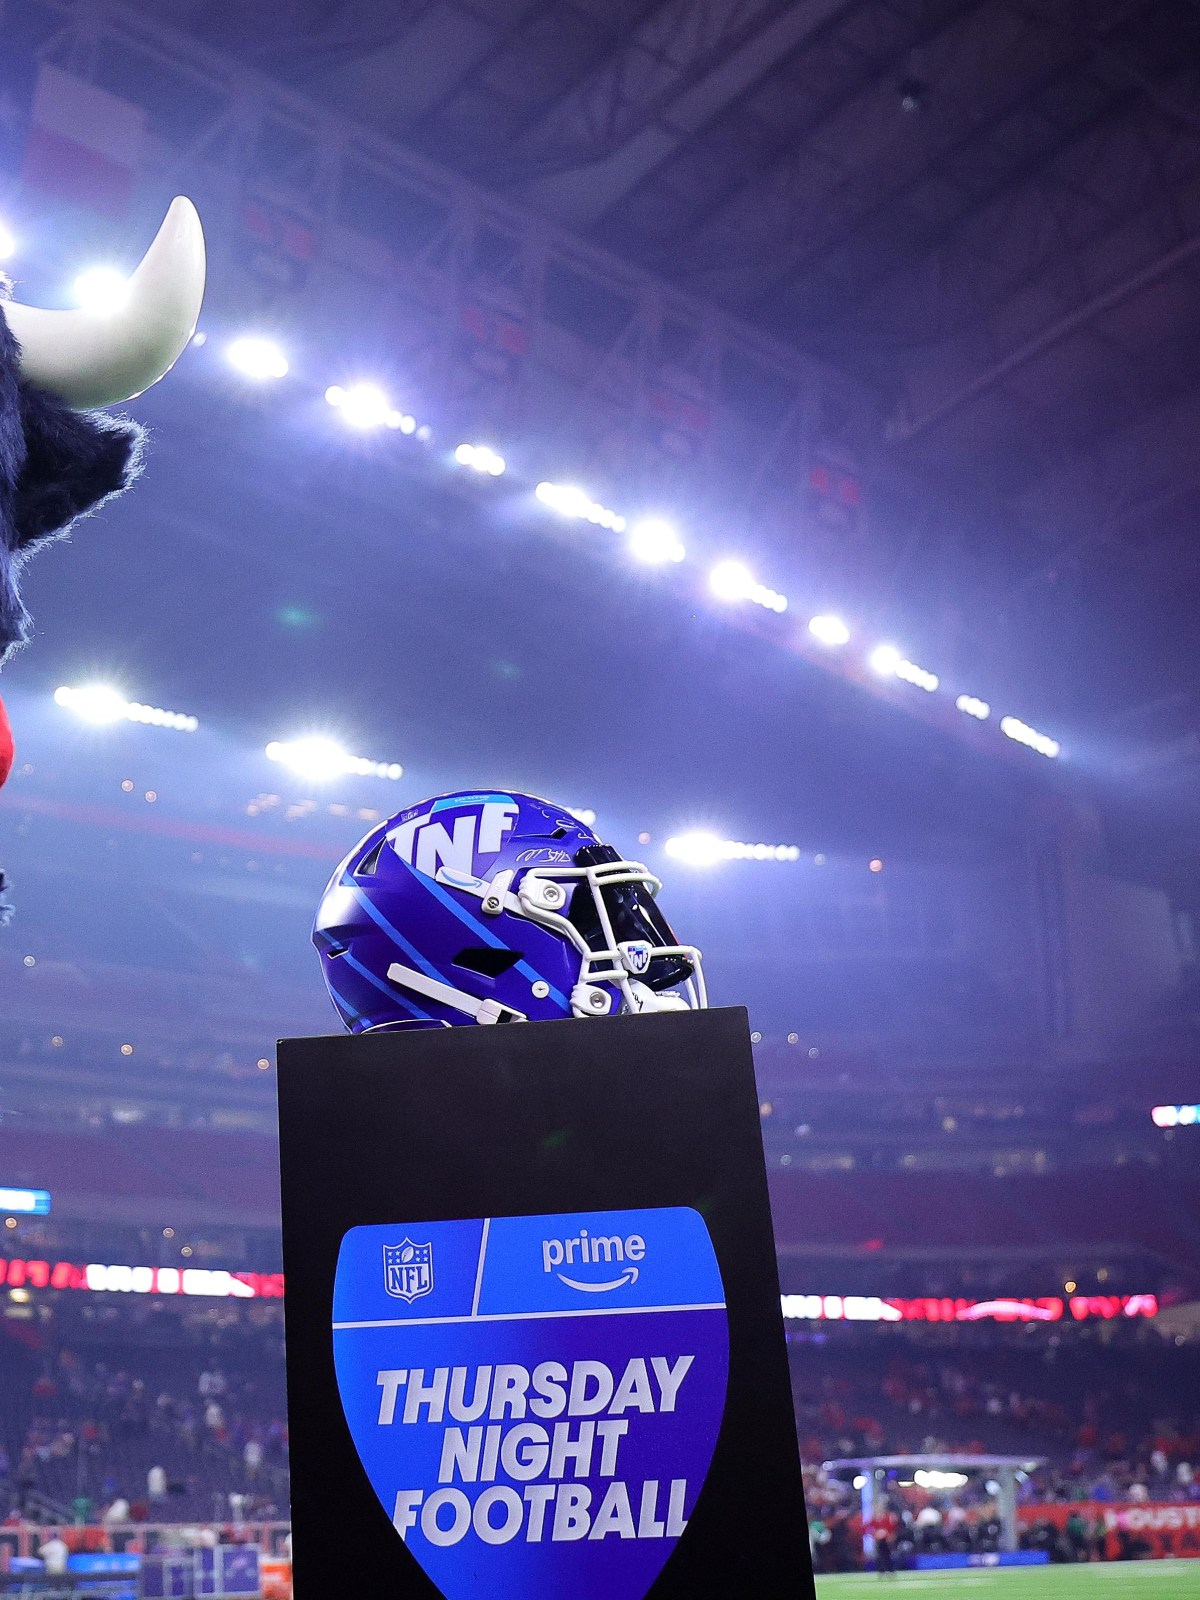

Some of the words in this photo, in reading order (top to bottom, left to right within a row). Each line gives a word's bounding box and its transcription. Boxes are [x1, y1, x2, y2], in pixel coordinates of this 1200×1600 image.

[386, 802, 520, 880] TNF
[627, 947, 649, 970] TNF
[390, 1266, 428, 1291] NFL
[542, 1229, 646, 1273] prime
[376, 1355, 695, 1425] THURSDAY
[437, 1419, 629, 1484] NIGHT
[393, 1478, 689, 1547] FOOTBALL
